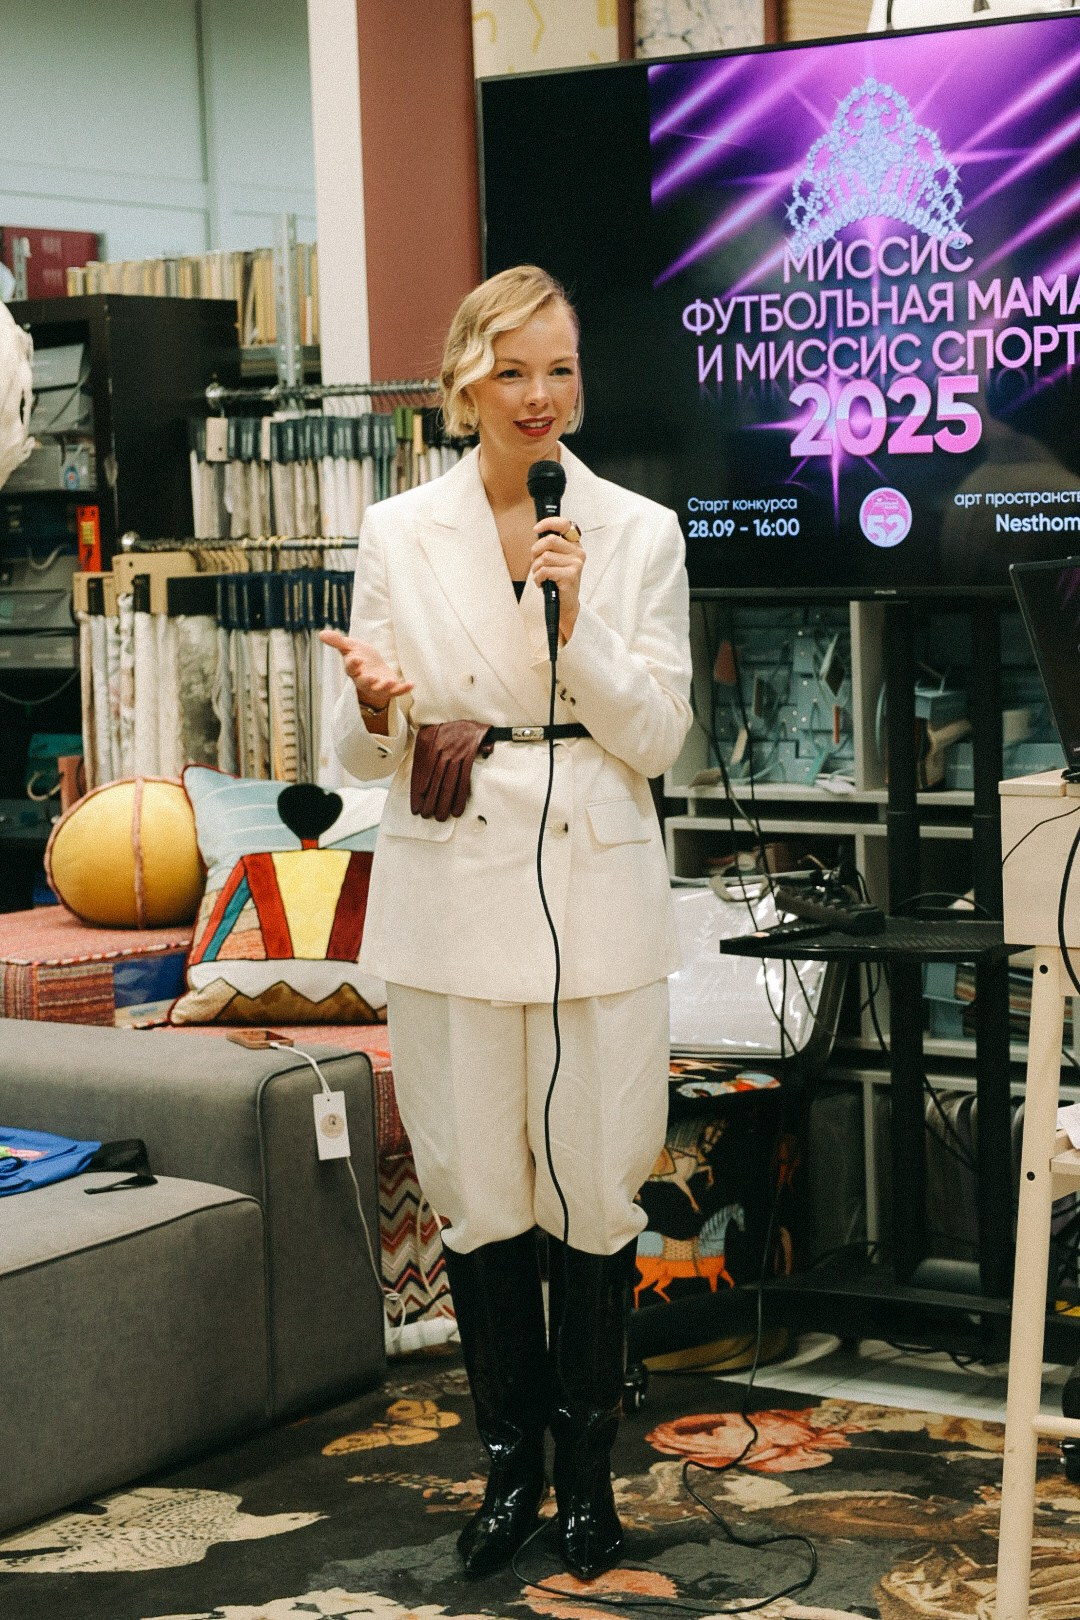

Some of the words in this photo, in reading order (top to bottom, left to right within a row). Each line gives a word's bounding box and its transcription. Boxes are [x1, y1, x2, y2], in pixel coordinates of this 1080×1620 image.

[783, 232, 974, 283] МИССИС
[682, 282, 954, 335] ФУТБОЛЬНАЯ
[698, 344, 724, 384] И
[736, 333, 921, 381] МИССИС
[789, 375, 982, 457] 2025
[687, 497, 729, 514] Старт
[732, 498, 798, 513] конкурса
[954, 493, 983, 509] арт
[688, 519, 735, 538] 28.09
[753, 518, 800, 537] 16:00
[866, 514, 907, 545] 52
